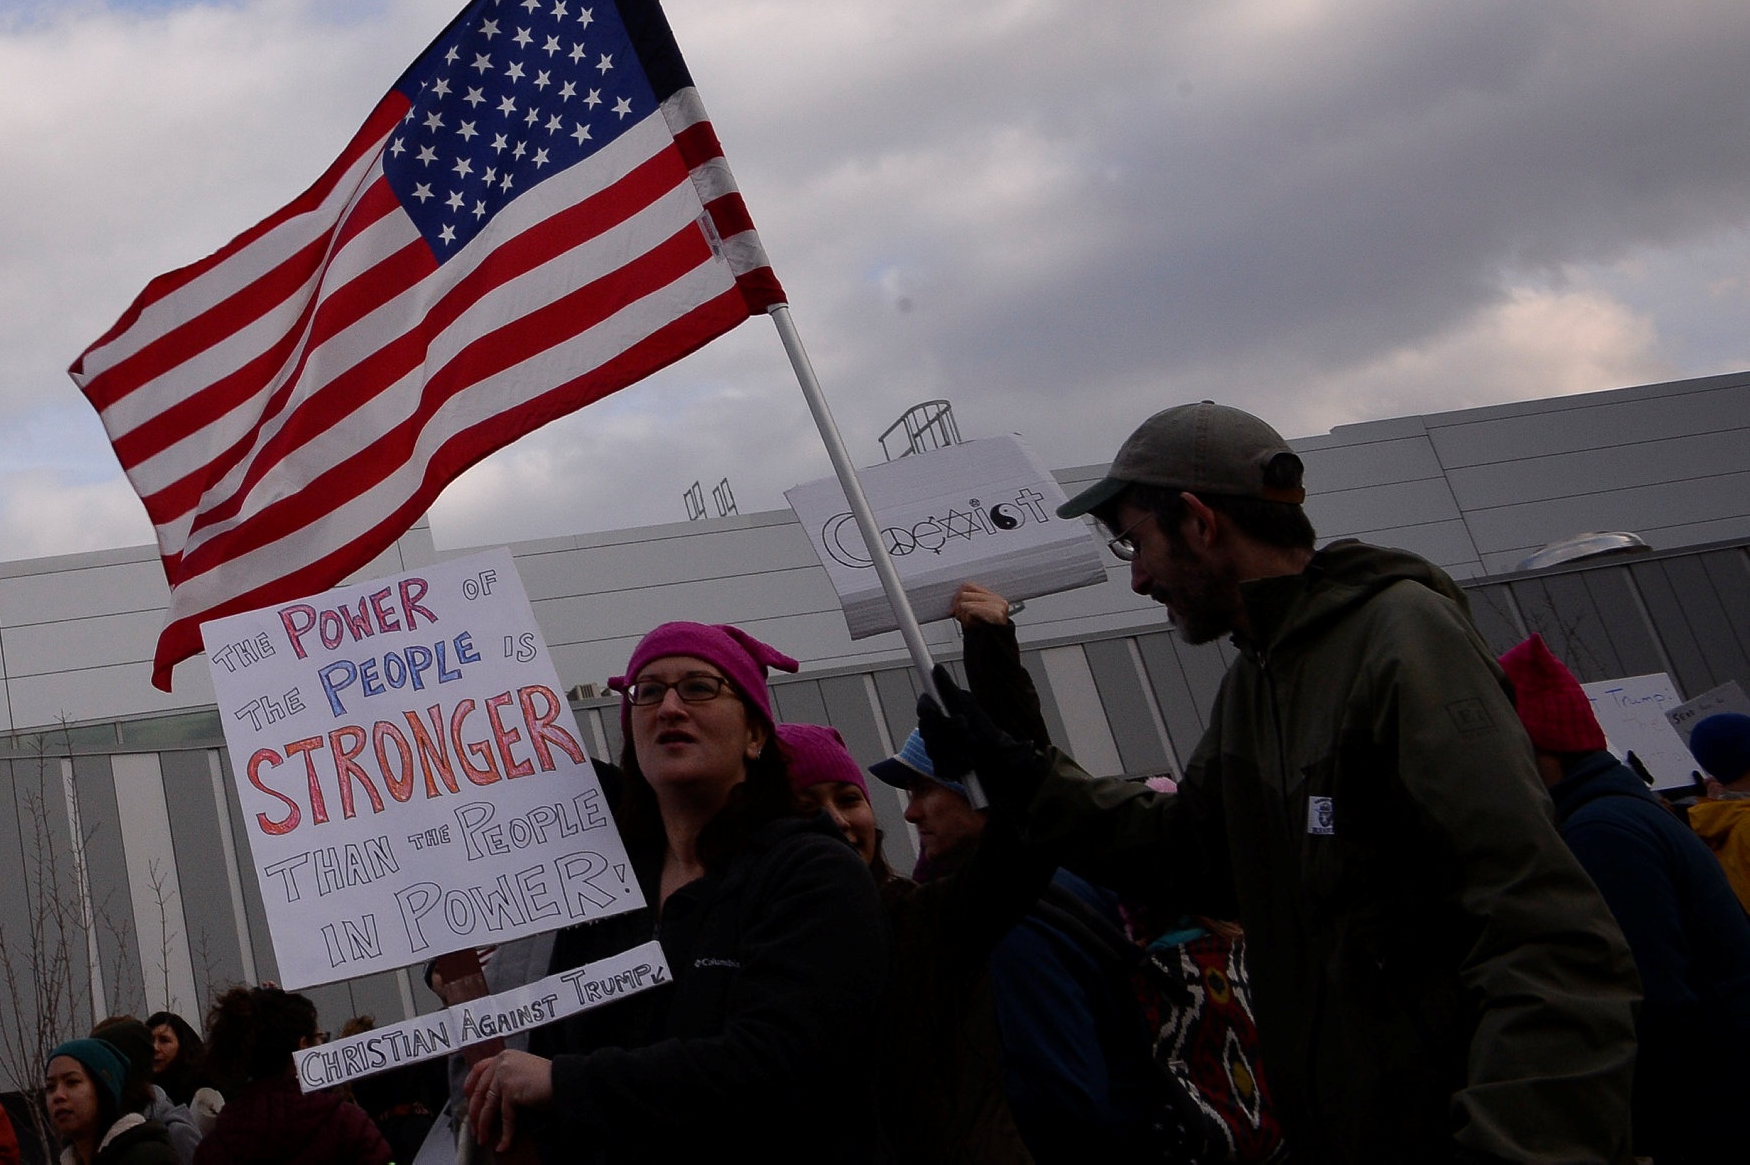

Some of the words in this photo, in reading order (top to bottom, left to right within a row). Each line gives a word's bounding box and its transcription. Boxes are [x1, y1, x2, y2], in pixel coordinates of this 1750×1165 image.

[212, 632, 276, 673] THE
[277, 577, 439, 659] POWER
[462, 570, 498, 601] OF
[318, 630, 481, 717] PEOPLE
[504, 633, 537, 663] IS
[247, 683, 587, 836] STRONGER
[265, 835, 400, 903] THAN
[408, 824, 451, 851] THE
[455, 788, 607, 861] PEOPLE
[322, 914, 381, 968] IN
[394, 851, 633, 953] POWER!
[300, 1022, 449, 1087] CHRISTIAN
[461, 993, 559, 1042] AGAINST
[561, 963, 652, 1006] TRUMP
